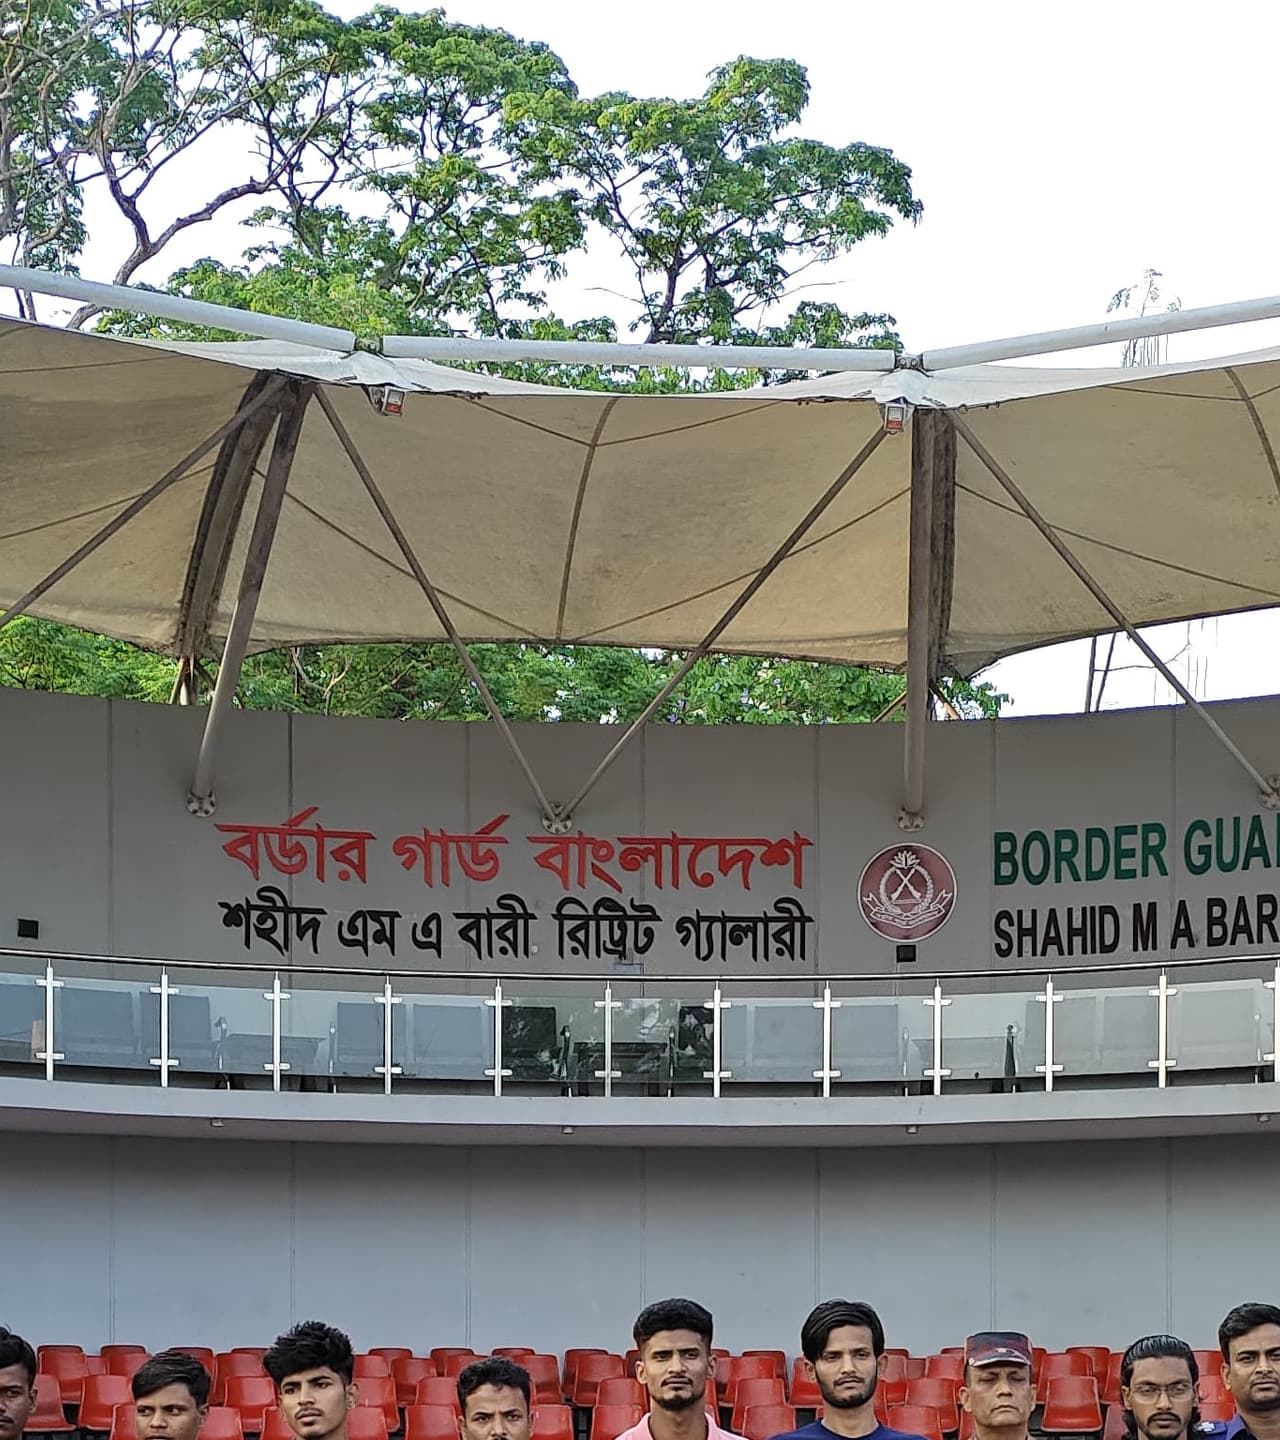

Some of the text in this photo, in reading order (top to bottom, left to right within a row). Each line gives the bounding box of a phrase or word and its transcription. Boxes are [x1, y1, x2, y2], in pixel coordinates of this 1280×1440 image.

[214, 806, 815, 893] বর্ডার গার্ড বাংলাদেশ
[994, 822, 1169, 886] BORDER
[217, 885, 328, 957] শহীদ
[337, 909, 403, 958] এম
[411, 912, 442, 960] এ
[452, 893, 538, 961] বারী
[675, 896, 815, 962] গ্যালারী
[994, 904, 1120, 958] SHAHID
[1132, 902, 1158, 952] M
[1170, 900, 1196, 950] A
